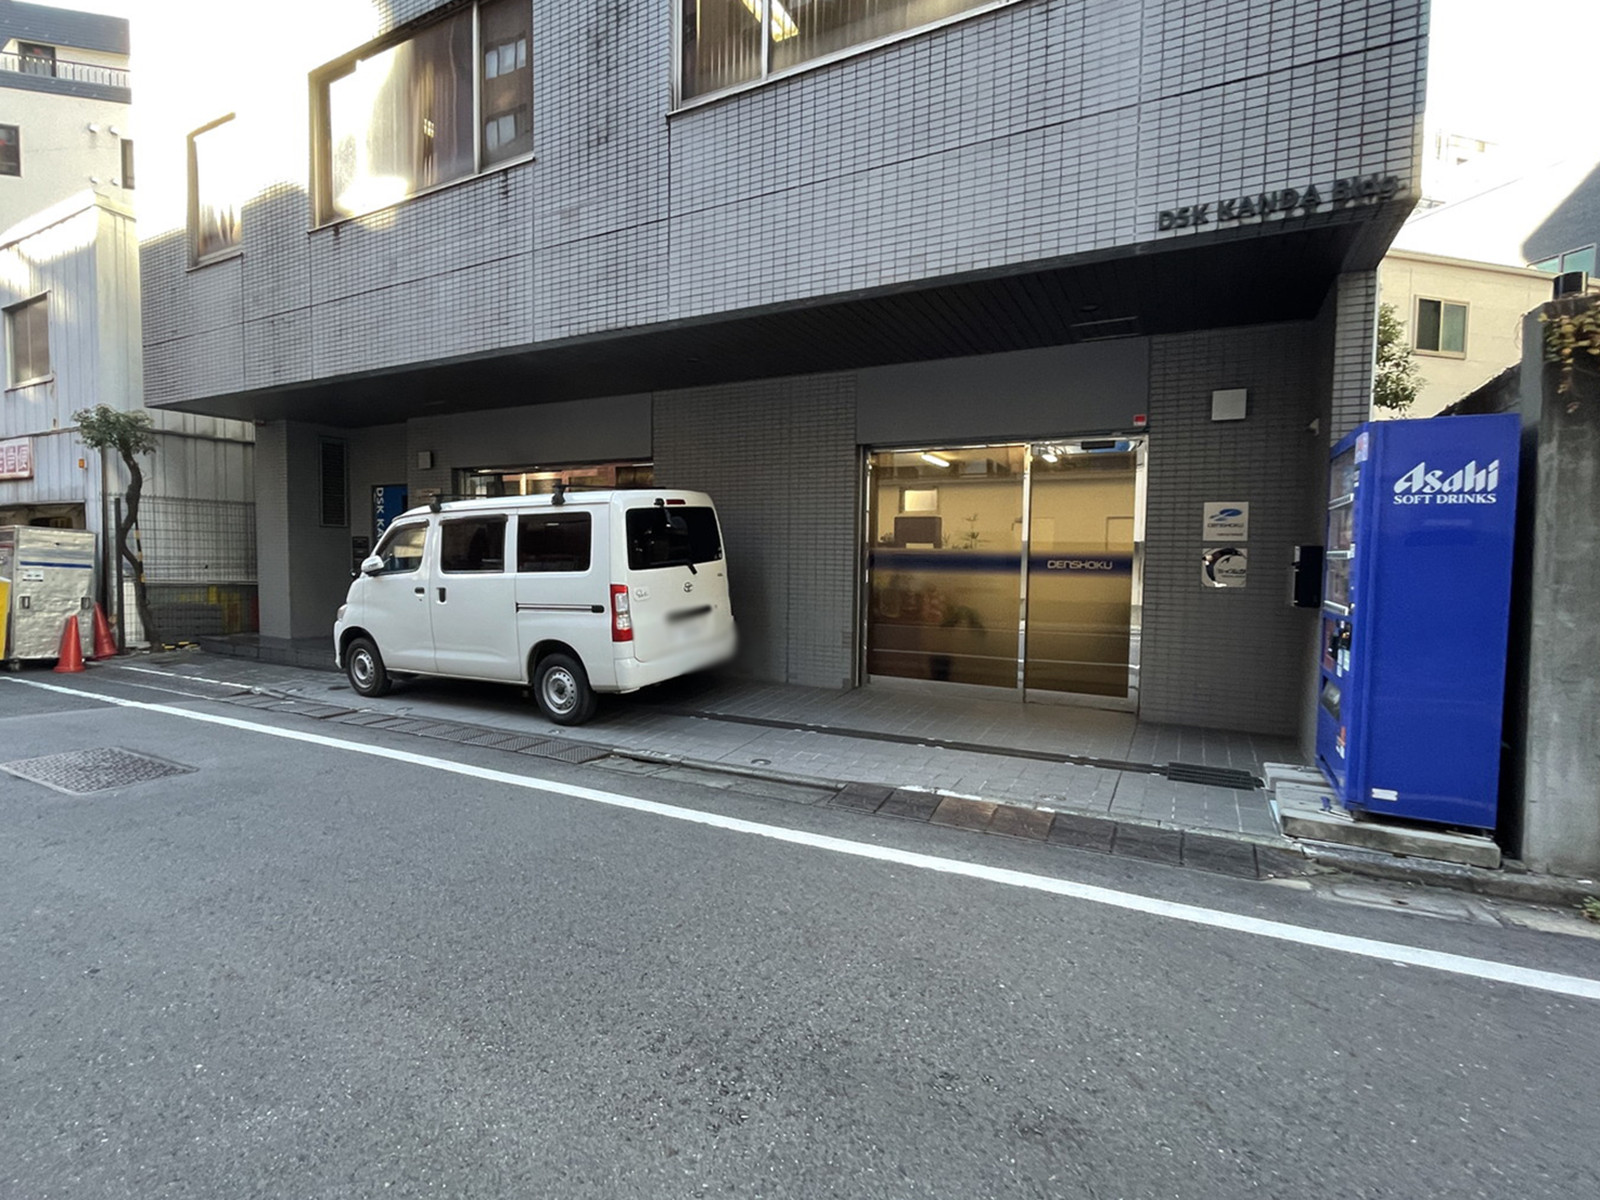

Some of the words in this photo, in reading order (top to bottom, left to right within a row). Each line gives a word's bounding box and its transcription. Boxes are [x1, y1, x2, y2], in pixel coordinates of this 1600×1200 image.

[1158, 203, 1209, 231] DSK
[1217, 183, 1322, 222] KANDA
[1393, 459, 1500, 493] Asahi
[376, 487, 385, 514] DSK
[1393, 494, 1433, 504] SOFT
[1436, 493, 1497, 504] DRINKS
[1047, 560, 1112, 569] DENSHOKU
